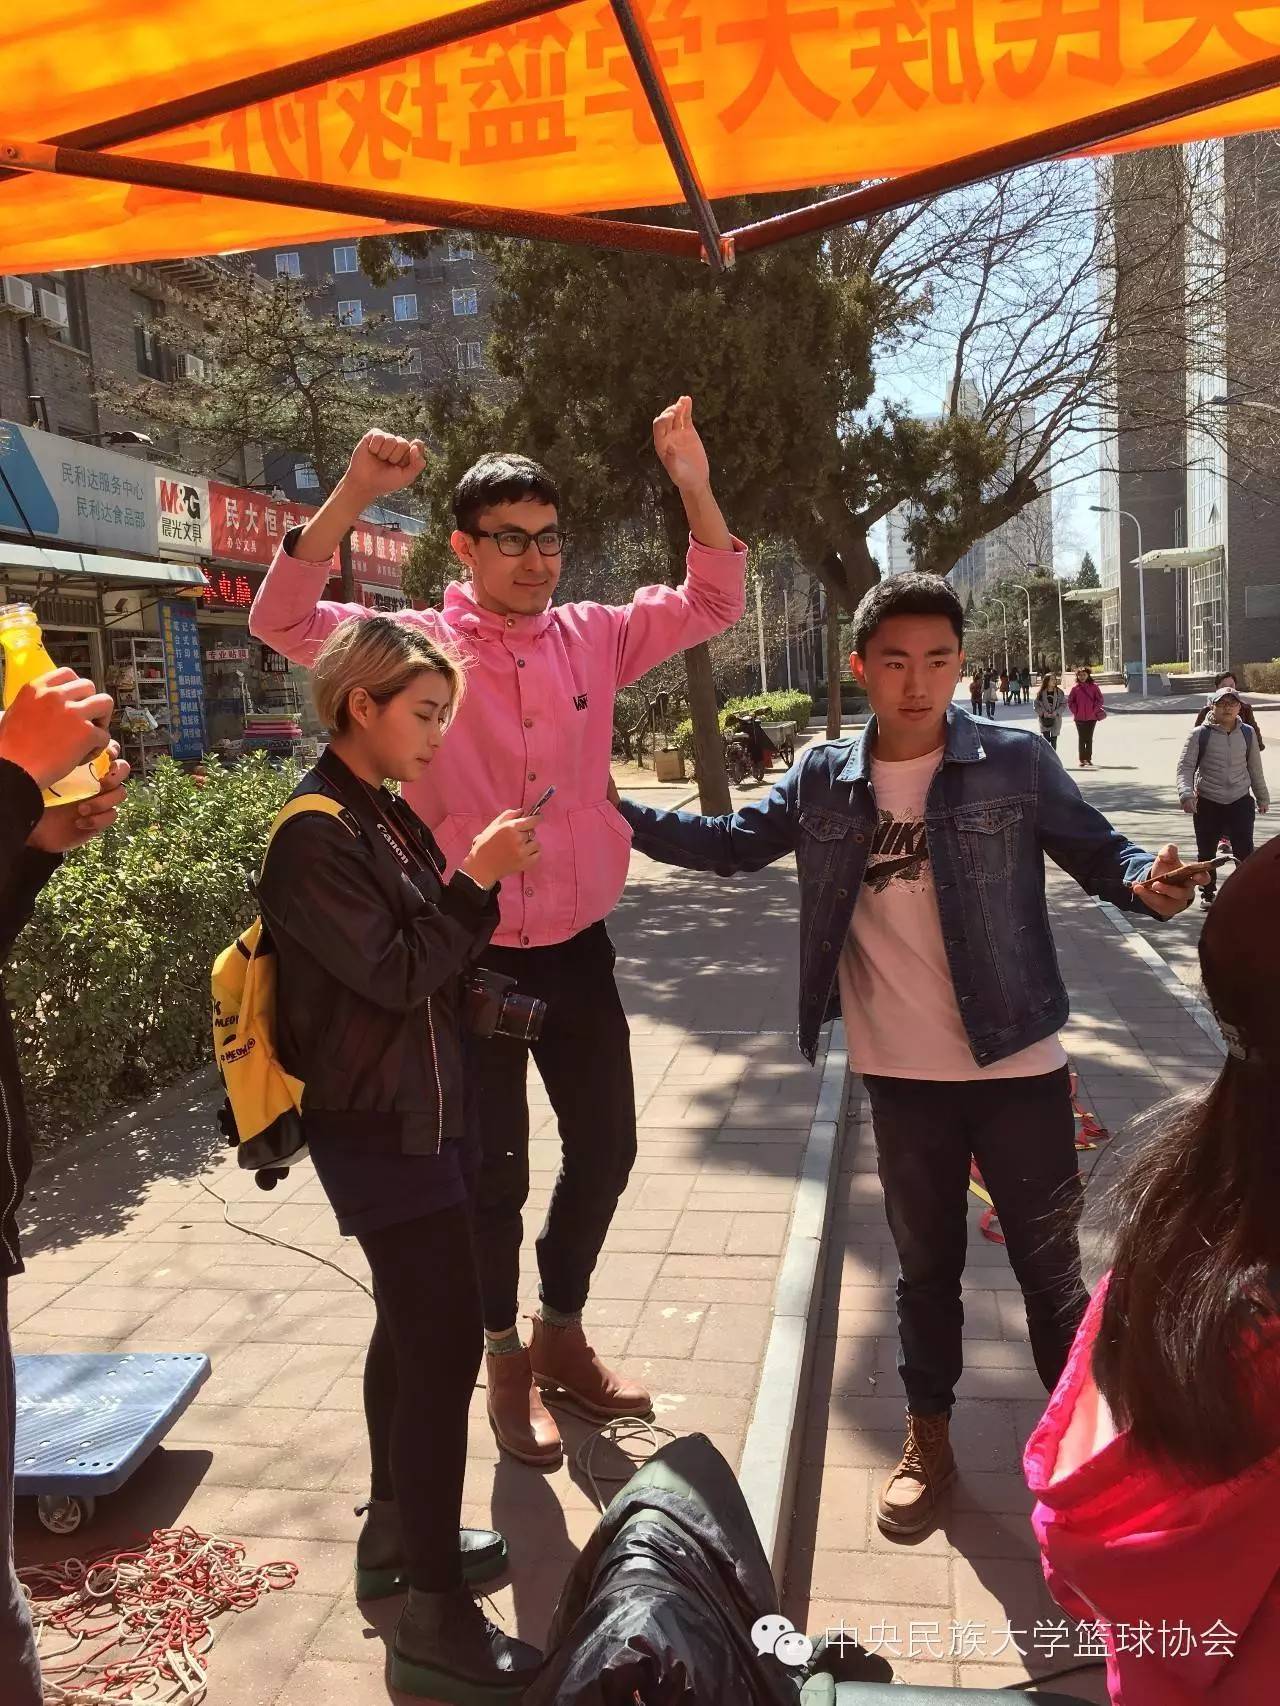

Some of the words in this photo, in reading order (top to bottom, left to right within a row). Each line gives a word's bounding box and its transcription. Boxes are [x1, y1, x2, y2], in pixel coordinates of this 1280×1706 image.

[61, 462, 144, 501] 民利达服务中心
[160, 479, 201, 520] M&G
[76, 496, 146, 530] 民利达食品部
[161, 516, 202, 543] 晨光文具
[226, 535, 257, 553] 办公文具
[376, 823, 409, 864] Canon
